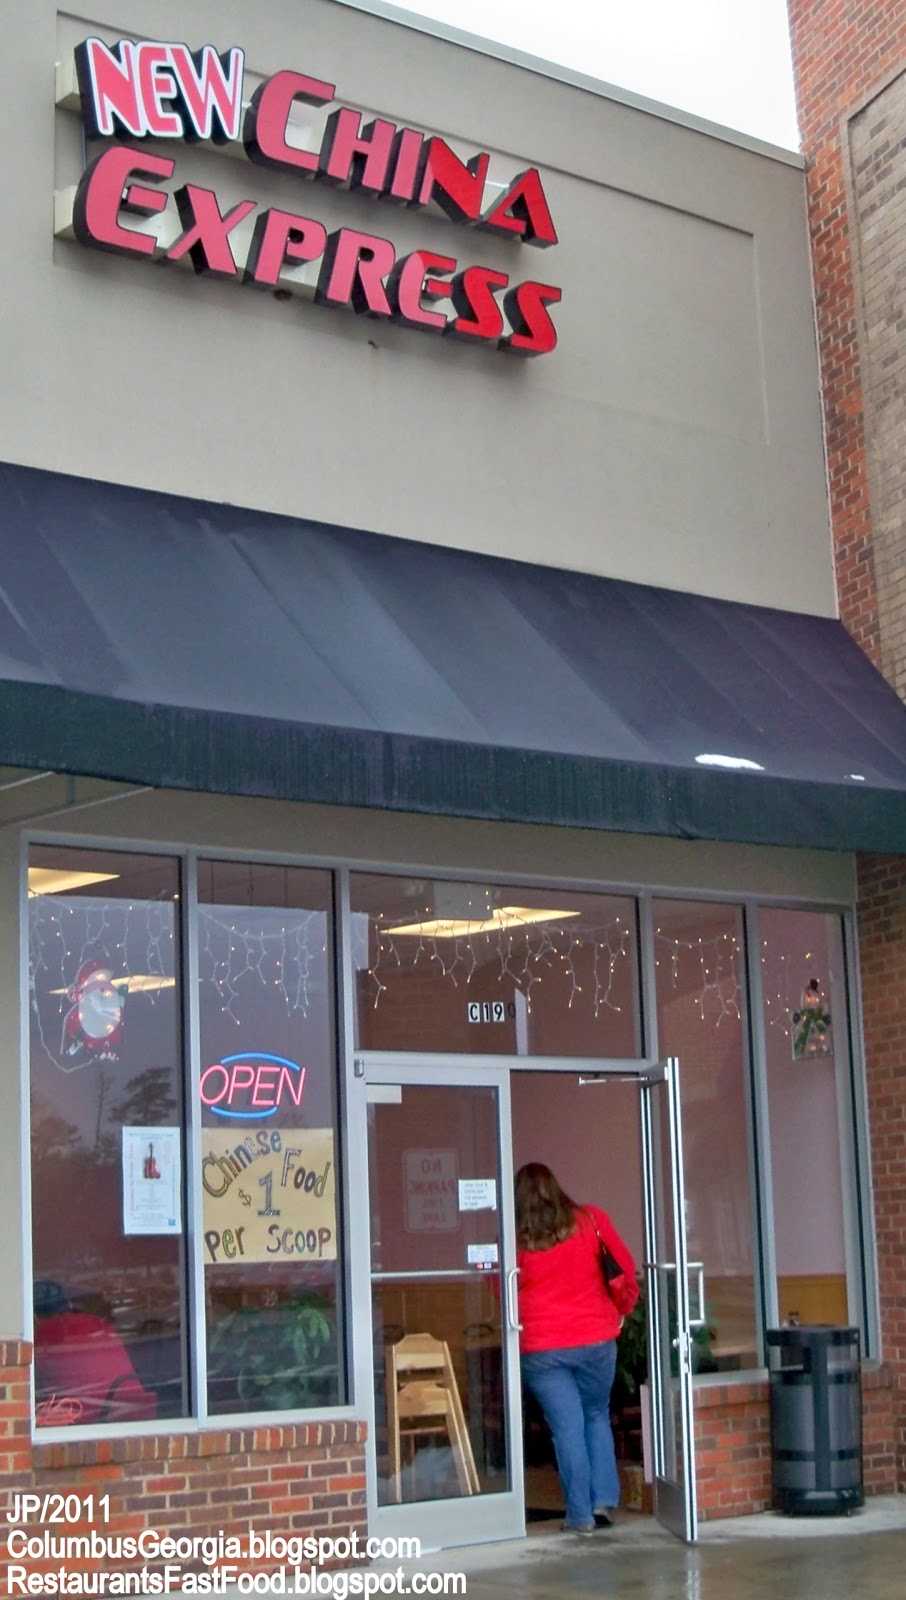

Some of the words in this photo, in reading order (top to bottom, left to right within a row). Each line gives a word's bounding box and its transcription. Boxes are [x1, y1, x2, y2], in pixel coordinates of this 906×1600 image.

[84, 36, 245, 140] NEW
[252, 70, 558, 245] CHINA
[84, 146, 562, 354] EXPRESS
[199, 1064, 306, 1106] OPEN
[202, 1130, 283, 1198] Chinese
[281, 1147, 332, 1198] Food
